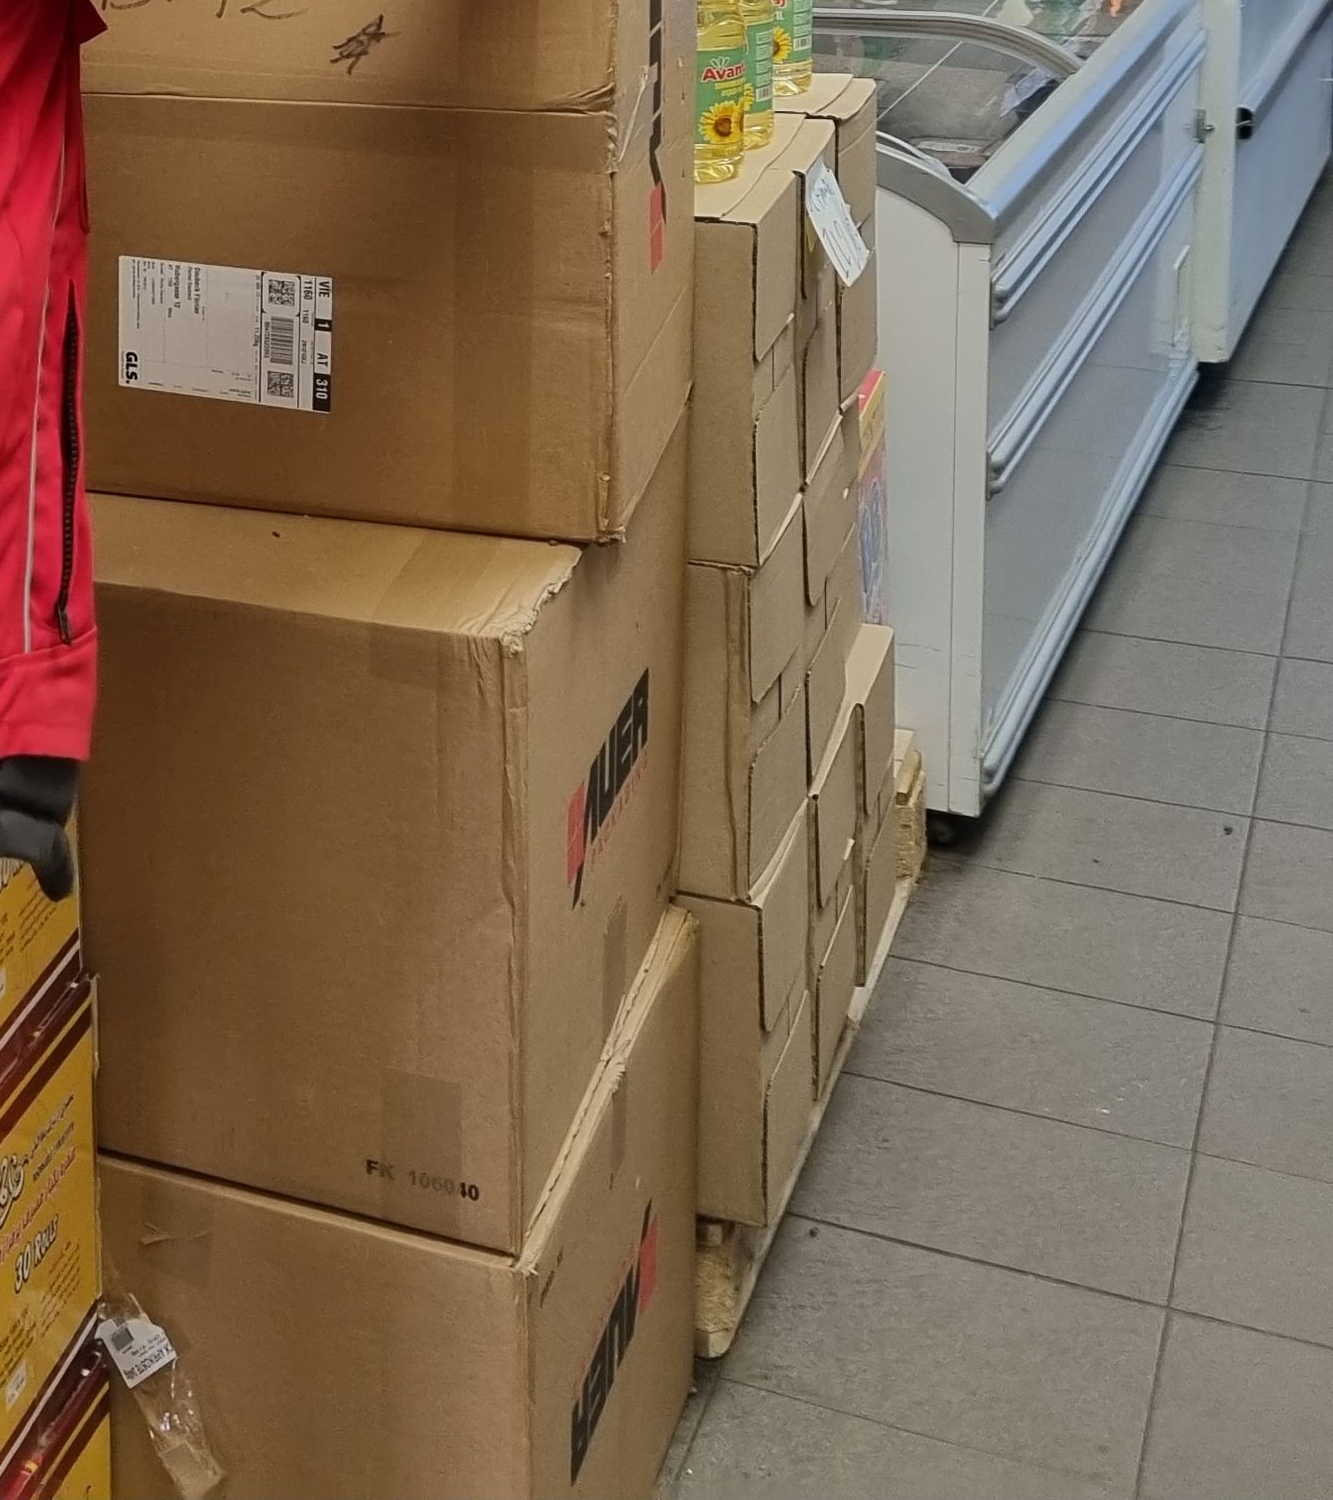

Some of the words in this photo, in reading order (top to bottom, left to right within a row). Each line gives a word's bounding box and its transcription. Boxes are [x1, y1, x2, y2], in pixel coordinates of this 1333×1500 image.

[700, 61, 746, 84] Avan
[317, 280, 330, 299] VIE
[317, 352, 329, 367] AT
[315, 377, 329, 400] 310
[366, 1159, 396, 1181] FK
[13, 1246, 33, 1294] 30
